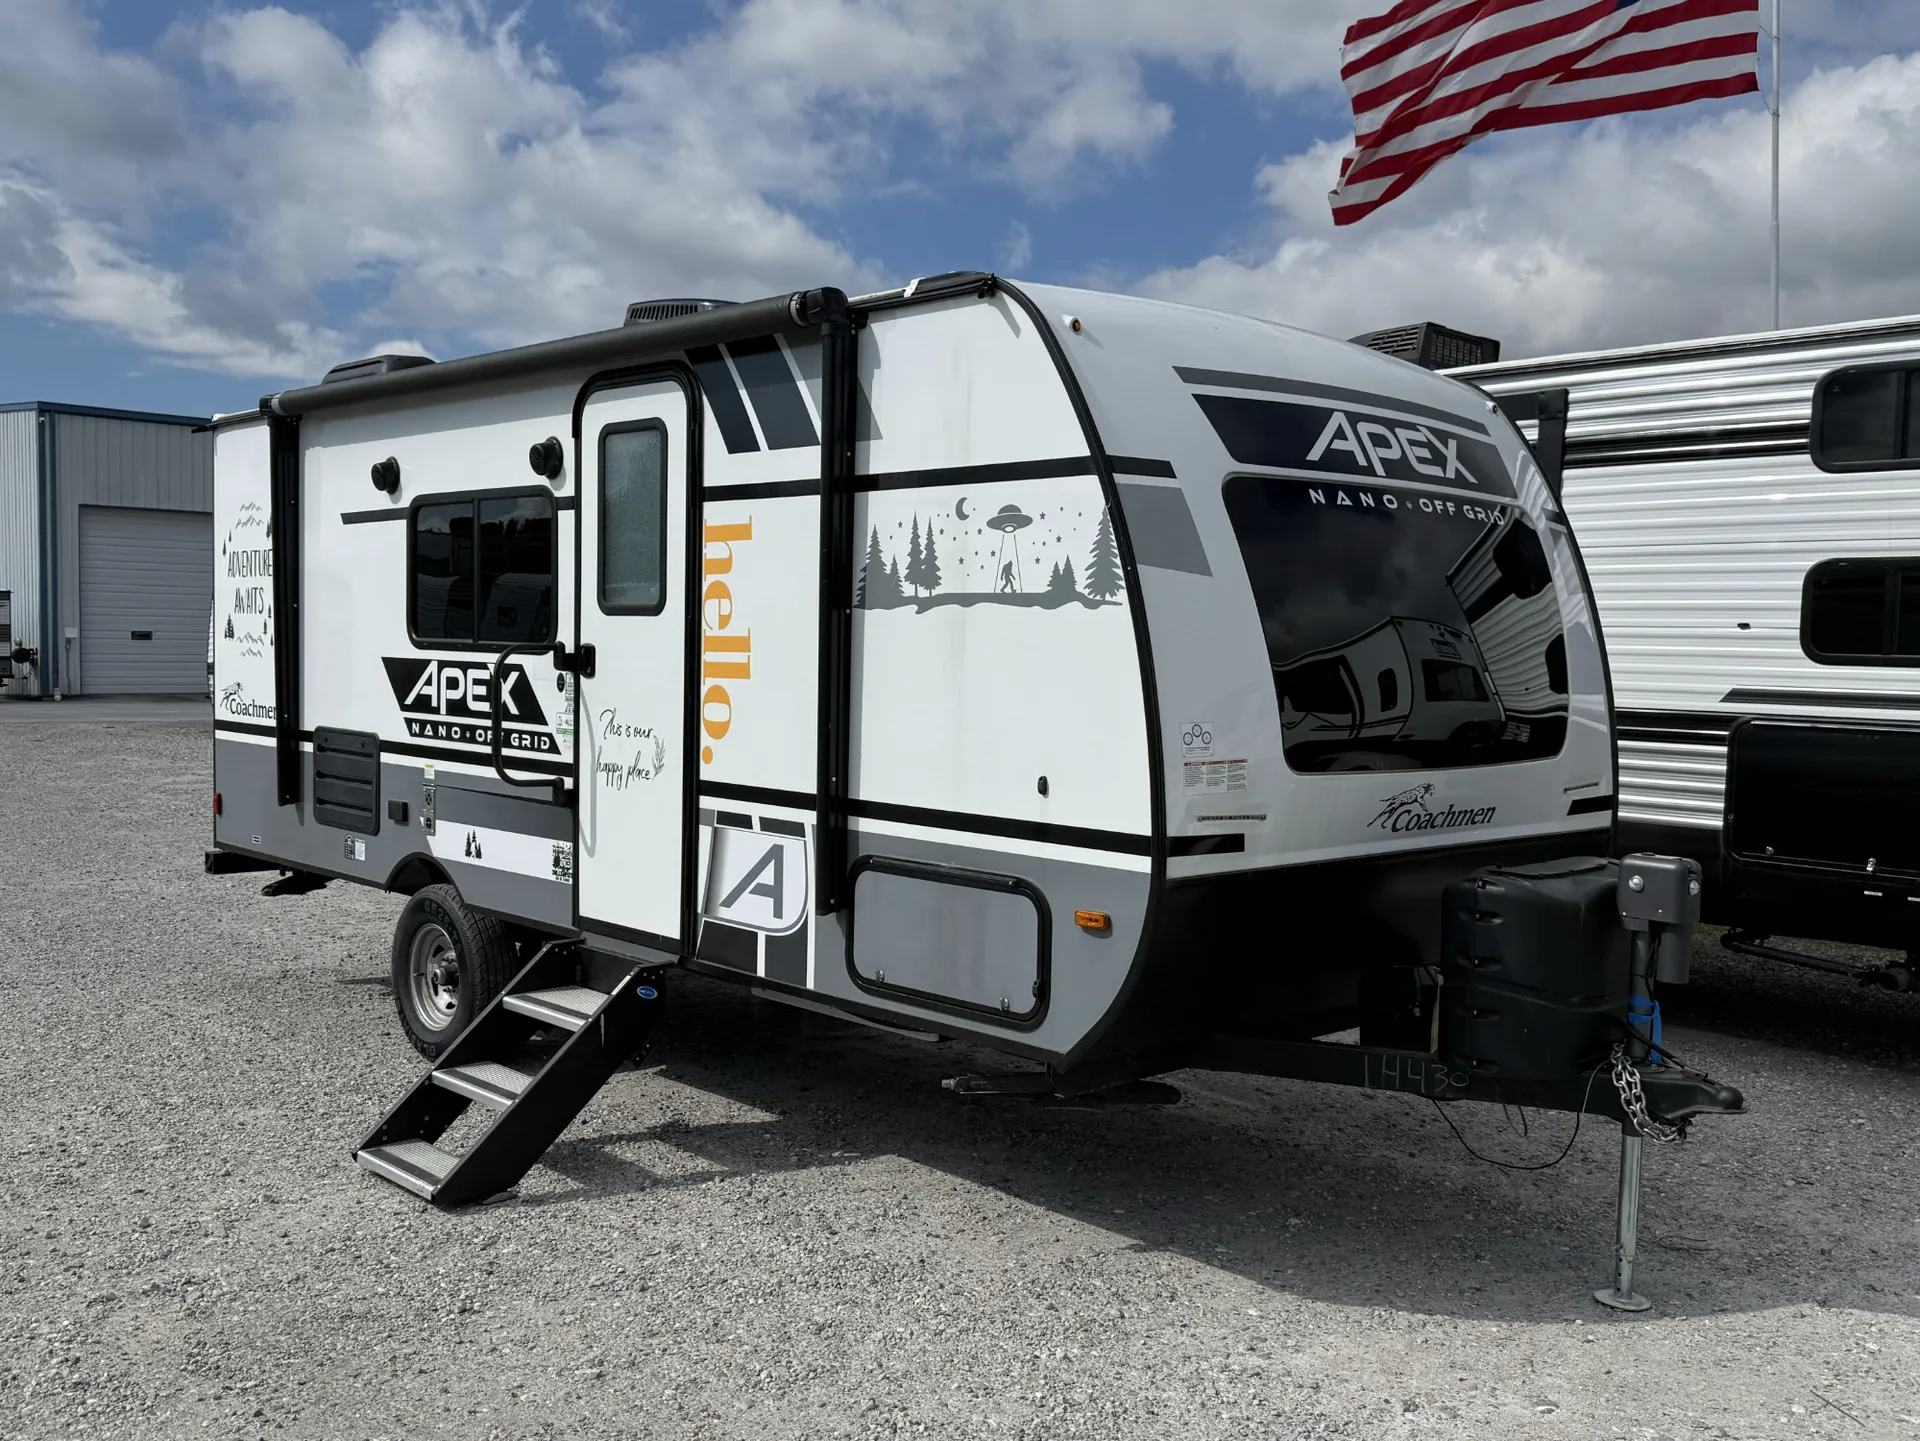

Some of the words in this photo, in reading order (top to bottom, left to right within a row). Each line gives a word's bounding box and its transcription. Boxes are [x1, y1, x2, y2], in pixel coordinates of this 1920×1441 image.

[1305, 411, 1478, 484] APEX
[1309, 488, 1398, 509] NANO
[1419, 498, 1456, 516] OFF
[1463, 505, 1504, 526] GRID
[227, 549, 273, 578] ADVENTURE
[234, 587, 264, 615] AWAITS
[702, 514, 752, 765] hello.
[403, 660, 520, 715] APEX
[411, 722, 461, 739] NANO
[475, 729, 504, 743] OF
[510, 733, 550, 750] GRID
[599, 707, 622, 740] This
[625, 724, 631, 738] is
[633, 727, 653, 739] our
[596, 745, 623, 791] happy
[625, 750, 651, 789] place
[1391, 804, 1496, 833] Coachmen
